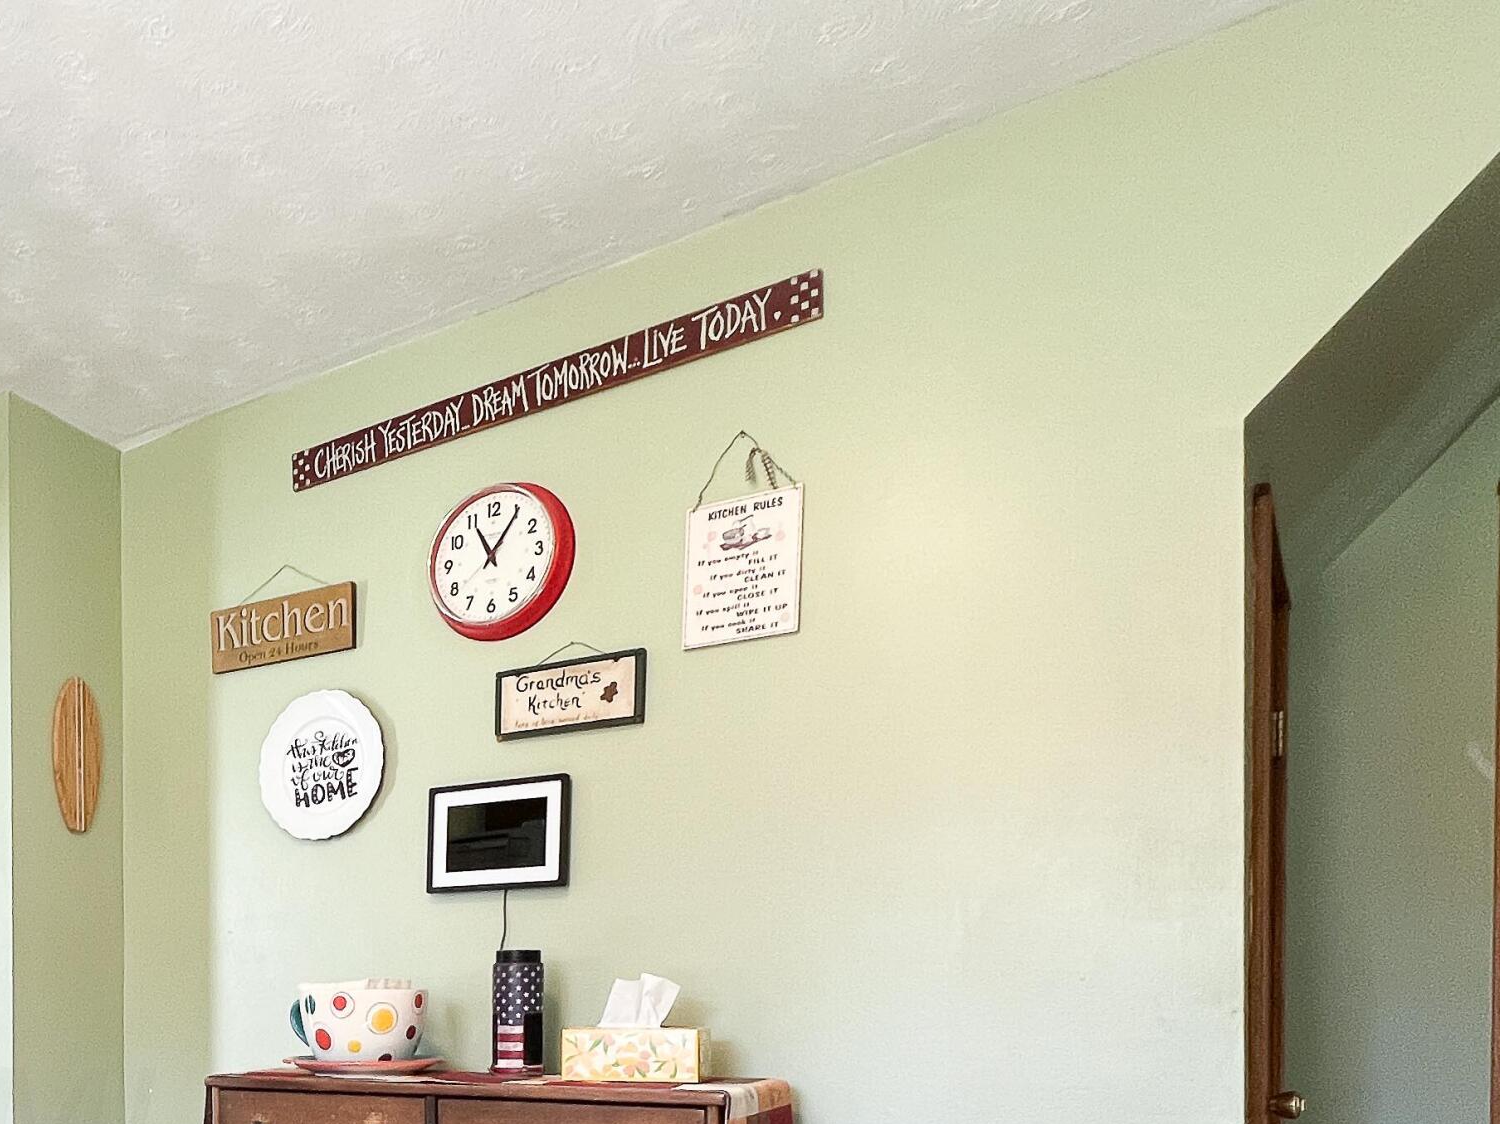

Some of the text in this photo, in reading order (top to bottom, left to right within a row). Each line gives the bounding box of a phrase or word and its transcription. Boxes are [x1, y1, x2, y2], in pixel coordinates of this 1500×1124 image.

[314, 430, 376, 479] CHERISH
[471, 375, 529, 426] DREAM
[642, 322, 687, 368] LIVE
[487, 501, 501, 518] 12
[708, 496, 784, 521] KITCHEN RULES
[468, 514, 478, 530] 11
[527, 518, 537, 534] 2
[451, 535, 464, 550] 10
[534, 540, 544, 555] 3
[444, 560, 453, 574] 9
[748, 556, 765, 565] FILL
[526, 566, 536, 581] 4
[744, 572, 774, 583] CLEAN
[450, 582, 459, 596] 8
[508, 587, 518, 602] 5
[737, 590, 765, 601] CLOSE
[466, 596, 474, 610] 7
[486, 599, 496, 613] 6
[736, 608, 758, 617] WIPE
[775, 603, 788, 611] UP
[217, 597, 350, 651] Kitchen
[736, 624, 766, 634] SHARE
[238, 650, 266, 665] Open
[285, 639, 319, 655] Hours
[516, 669, 601, 692] Grandma's
[527, 693, 582, 715] Kitchen
[294, 767, 359, 808] HOME
